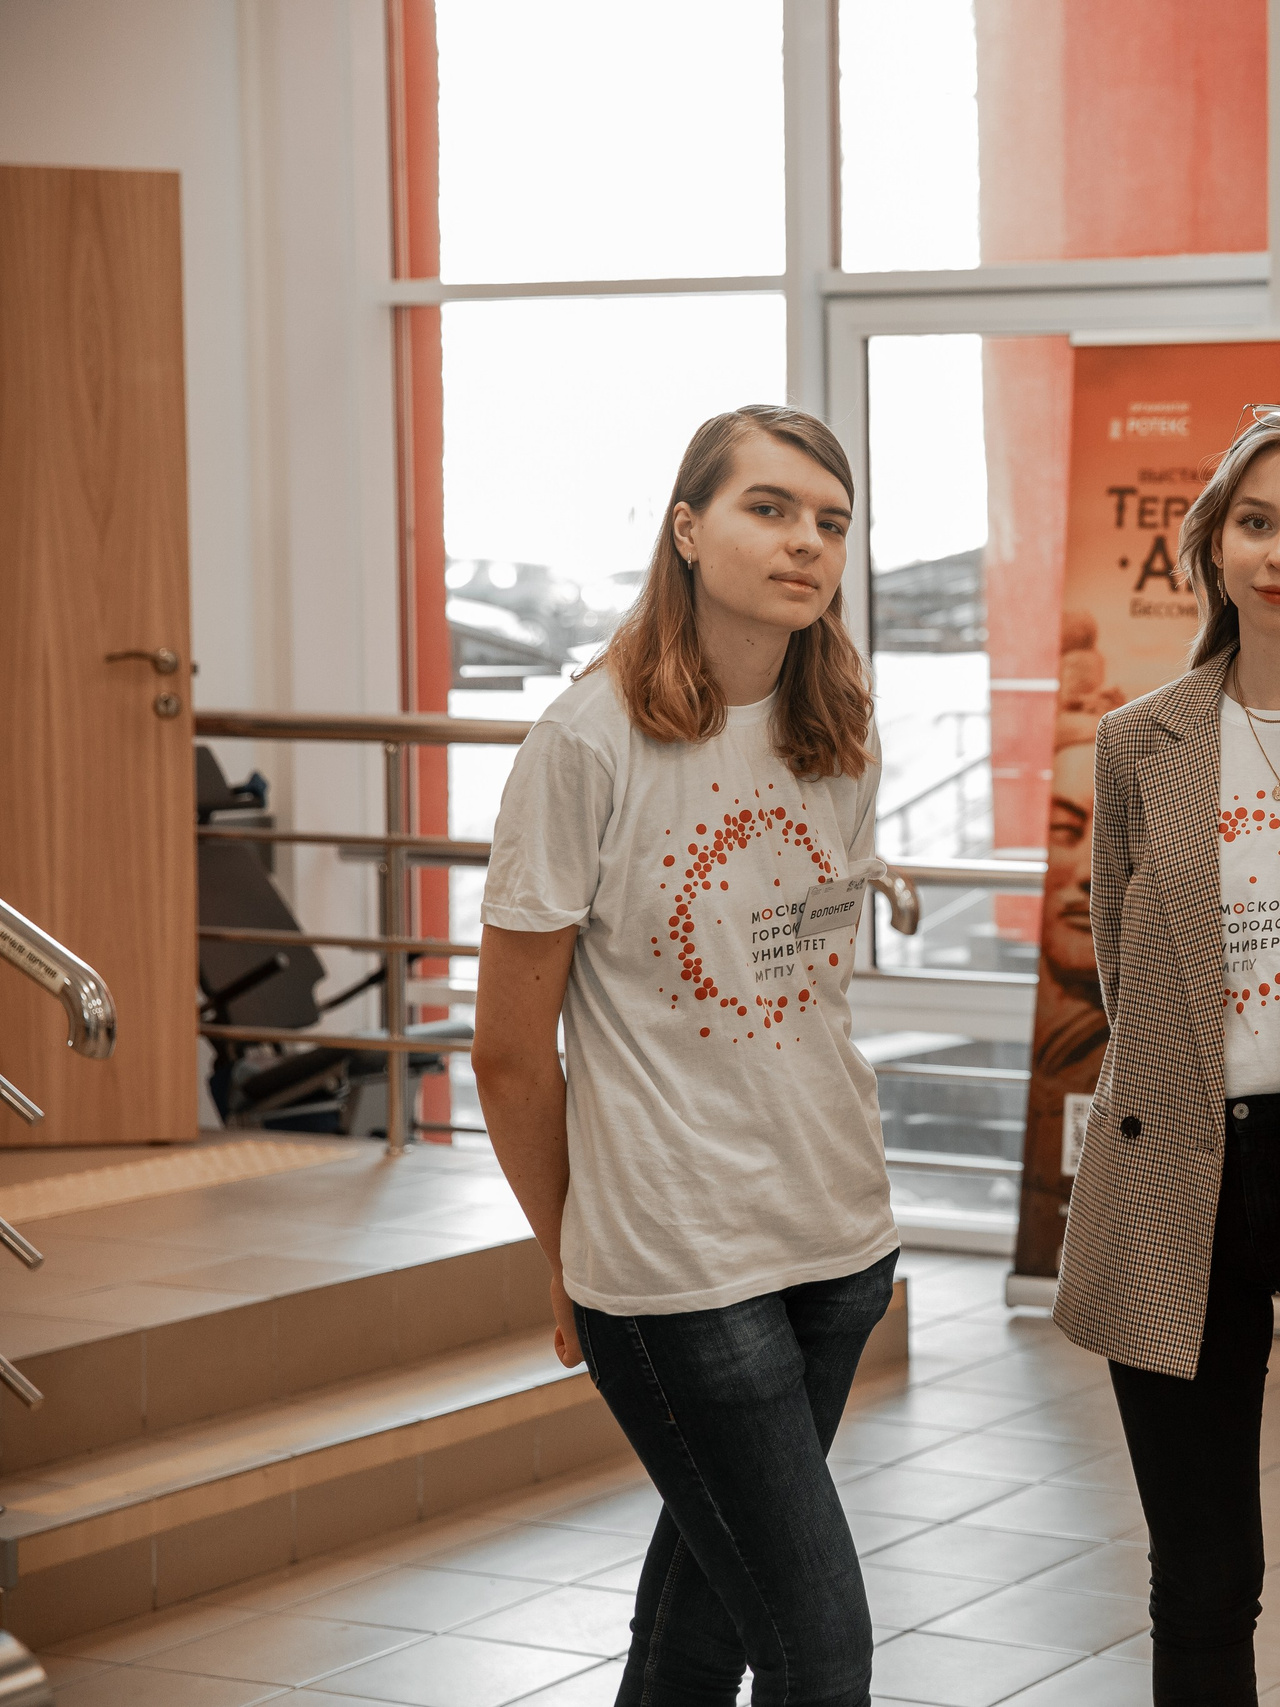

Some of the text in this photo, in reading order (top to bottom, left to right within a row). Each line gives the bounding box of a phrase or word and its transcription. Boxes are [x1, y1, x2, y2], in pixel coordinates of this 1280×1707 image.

[810, 901, 855, 920] ВОЛОНТЕР
[752, 938, 826, 963] УНИВИТЕТ
[755, 964, 795, 983] МГПУ
